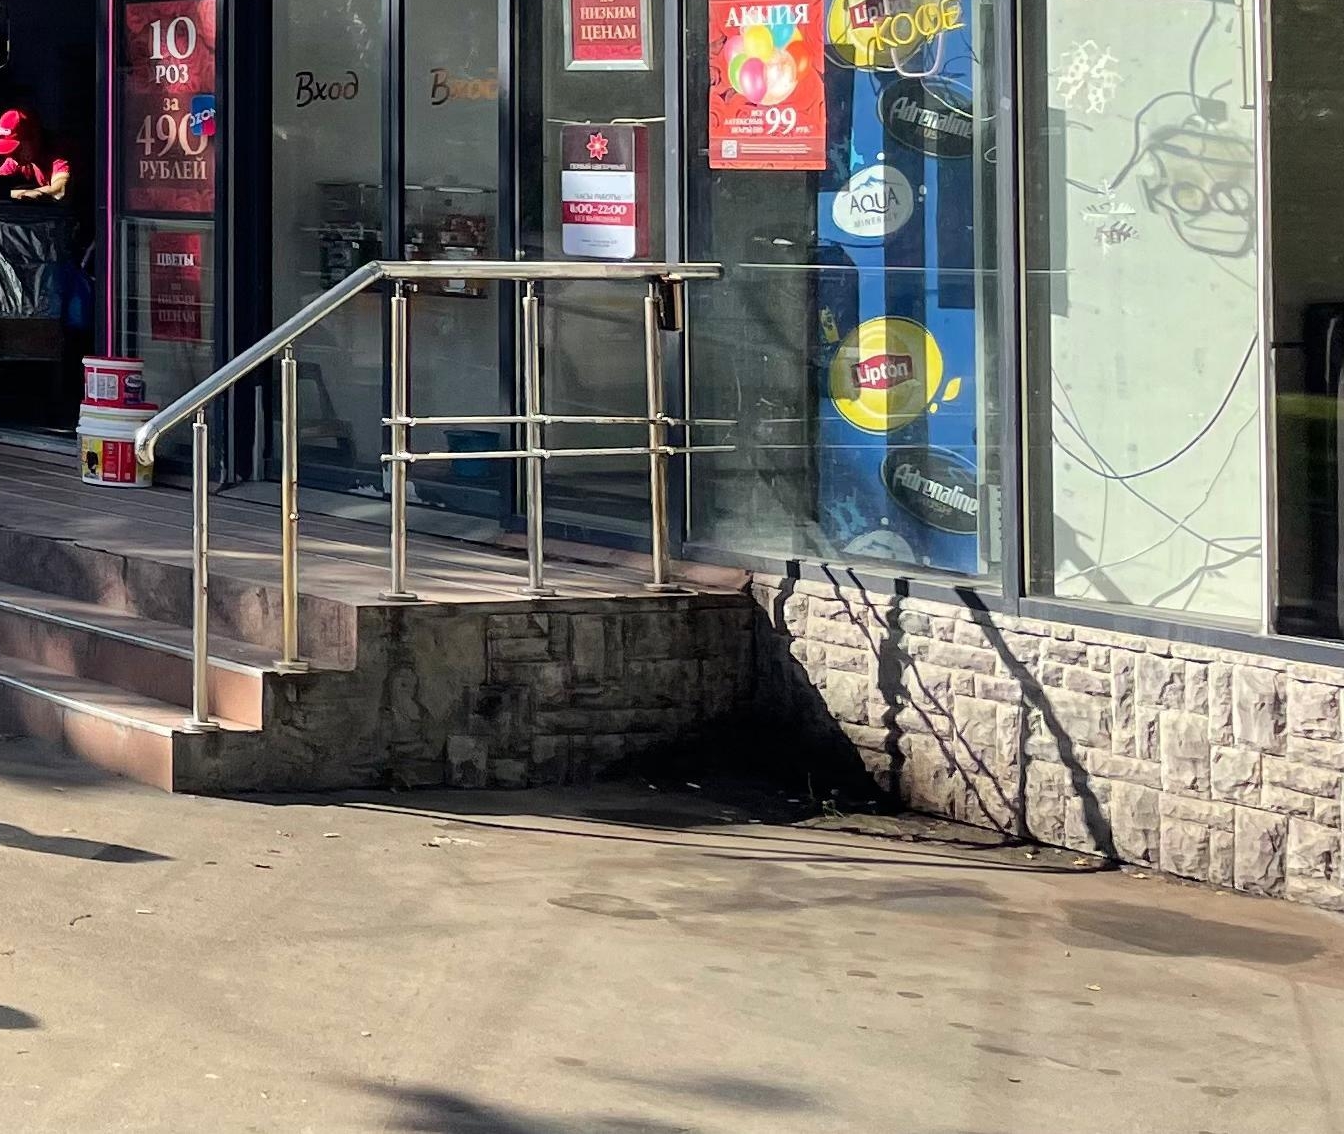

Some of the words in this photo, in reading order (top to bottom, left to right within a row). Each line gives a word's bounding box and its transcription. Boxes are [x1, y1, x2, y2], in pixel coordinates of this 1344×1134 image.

[580, 7, 636, 20] НИЗКИМ
[725, 3, 810, 29] АКЦИЯ
[150, 16, 197, 60] 10
[581, 24, 637, 42] ЦЕНАМ
[155, 64, 189, 84] РОЗ
[296, 71, 359, 107] Вход
[163, 97, 180, 111] за
[765, 107, 797, 136] 99
[136, 113, 209, 157] 490
[139, 158, 207, 181] РУБЛЕЙ
[850, 187, 901, 215] AQUA
[156, 252, 195, 267] ЦВЕТЫ
[856, 357, 910, 383] Lipton
[894, 463, 979, 516] Adrenaline
